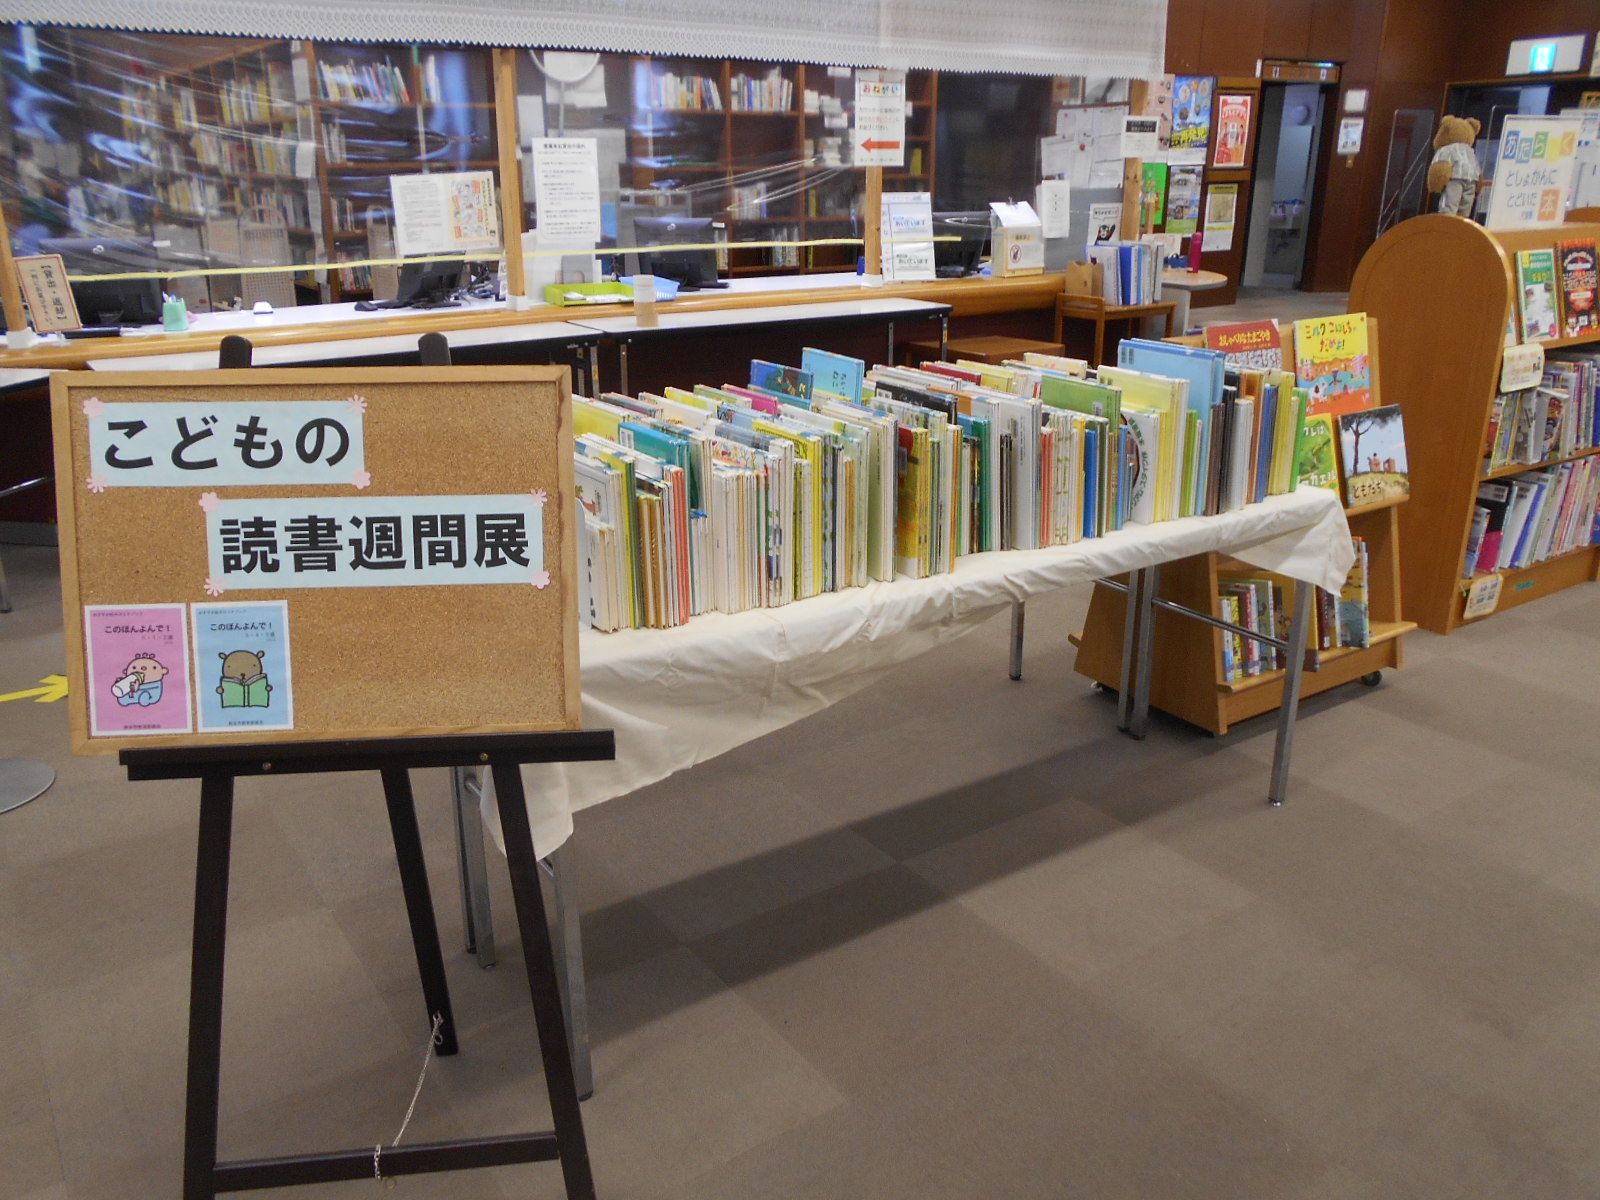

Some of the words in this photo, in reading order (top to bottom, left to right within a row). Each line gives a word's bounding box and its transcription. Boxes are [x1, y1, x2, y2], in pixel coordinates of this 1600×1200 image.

[1505, 168, 1557, 187] としょかんに
[1507, 192, 1537, 208] とどいた
[1541, 192, 1557, 217] 本
[104, 416, 350, 471] こどもの
[1353, 481, 1382, 499] ともだち
[220, 512, 531, 575] 読書週間展
